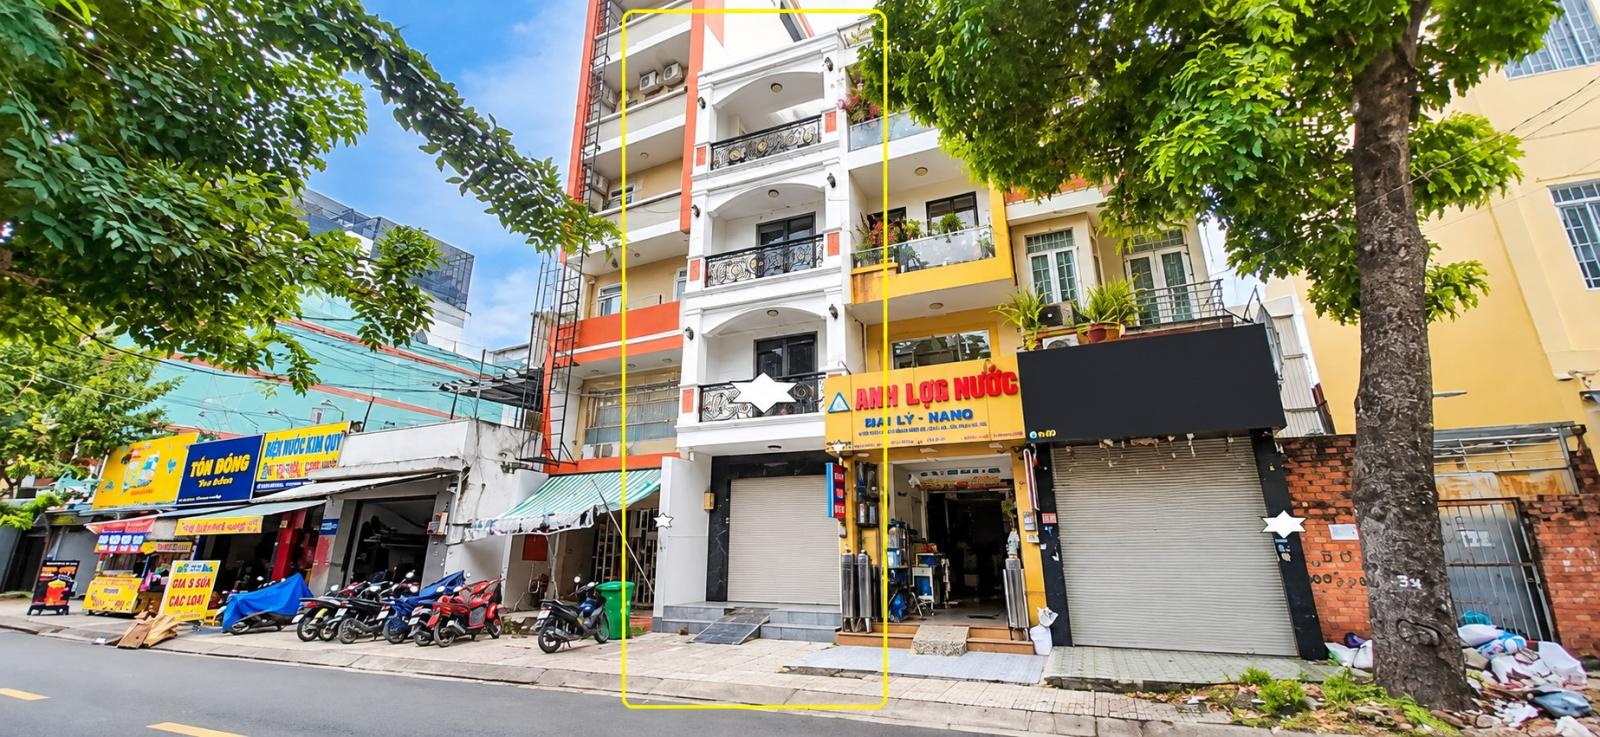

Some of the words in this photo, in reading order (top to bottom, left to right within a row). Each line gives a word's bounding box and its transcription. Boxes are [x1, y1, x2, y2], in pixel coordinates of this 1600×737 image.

[855, 385, 898, 410] ANH
[953, 364, 1018, 401] NƯỚC
[928, 408, 973, 423] NANO
